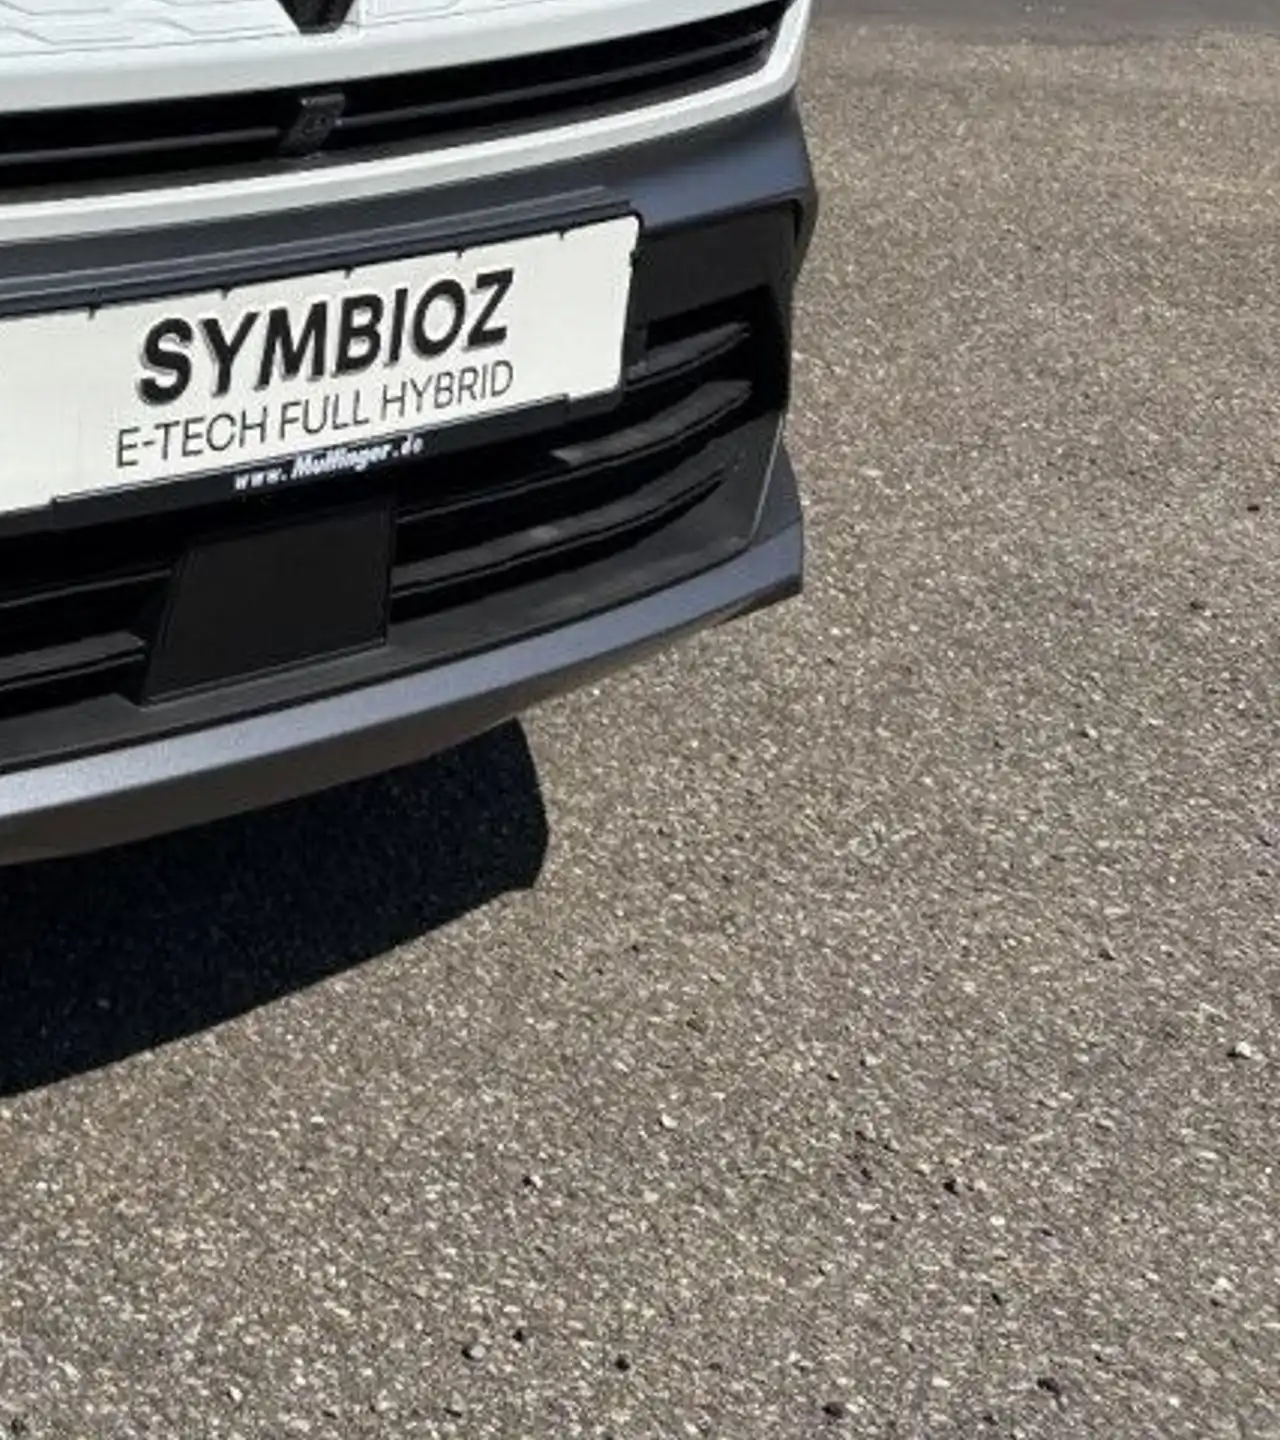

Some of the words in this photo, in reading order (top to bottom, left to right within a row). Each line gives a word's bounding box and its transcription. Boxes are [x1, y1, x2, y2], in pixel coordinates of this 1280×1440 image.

[138, 268, 514, 406] SYMBIOZ
[116, 405, 269, 469] E-TECH
[279, 389, 370, 441] FULL
[379, 359, 514, 421] HYBRID
